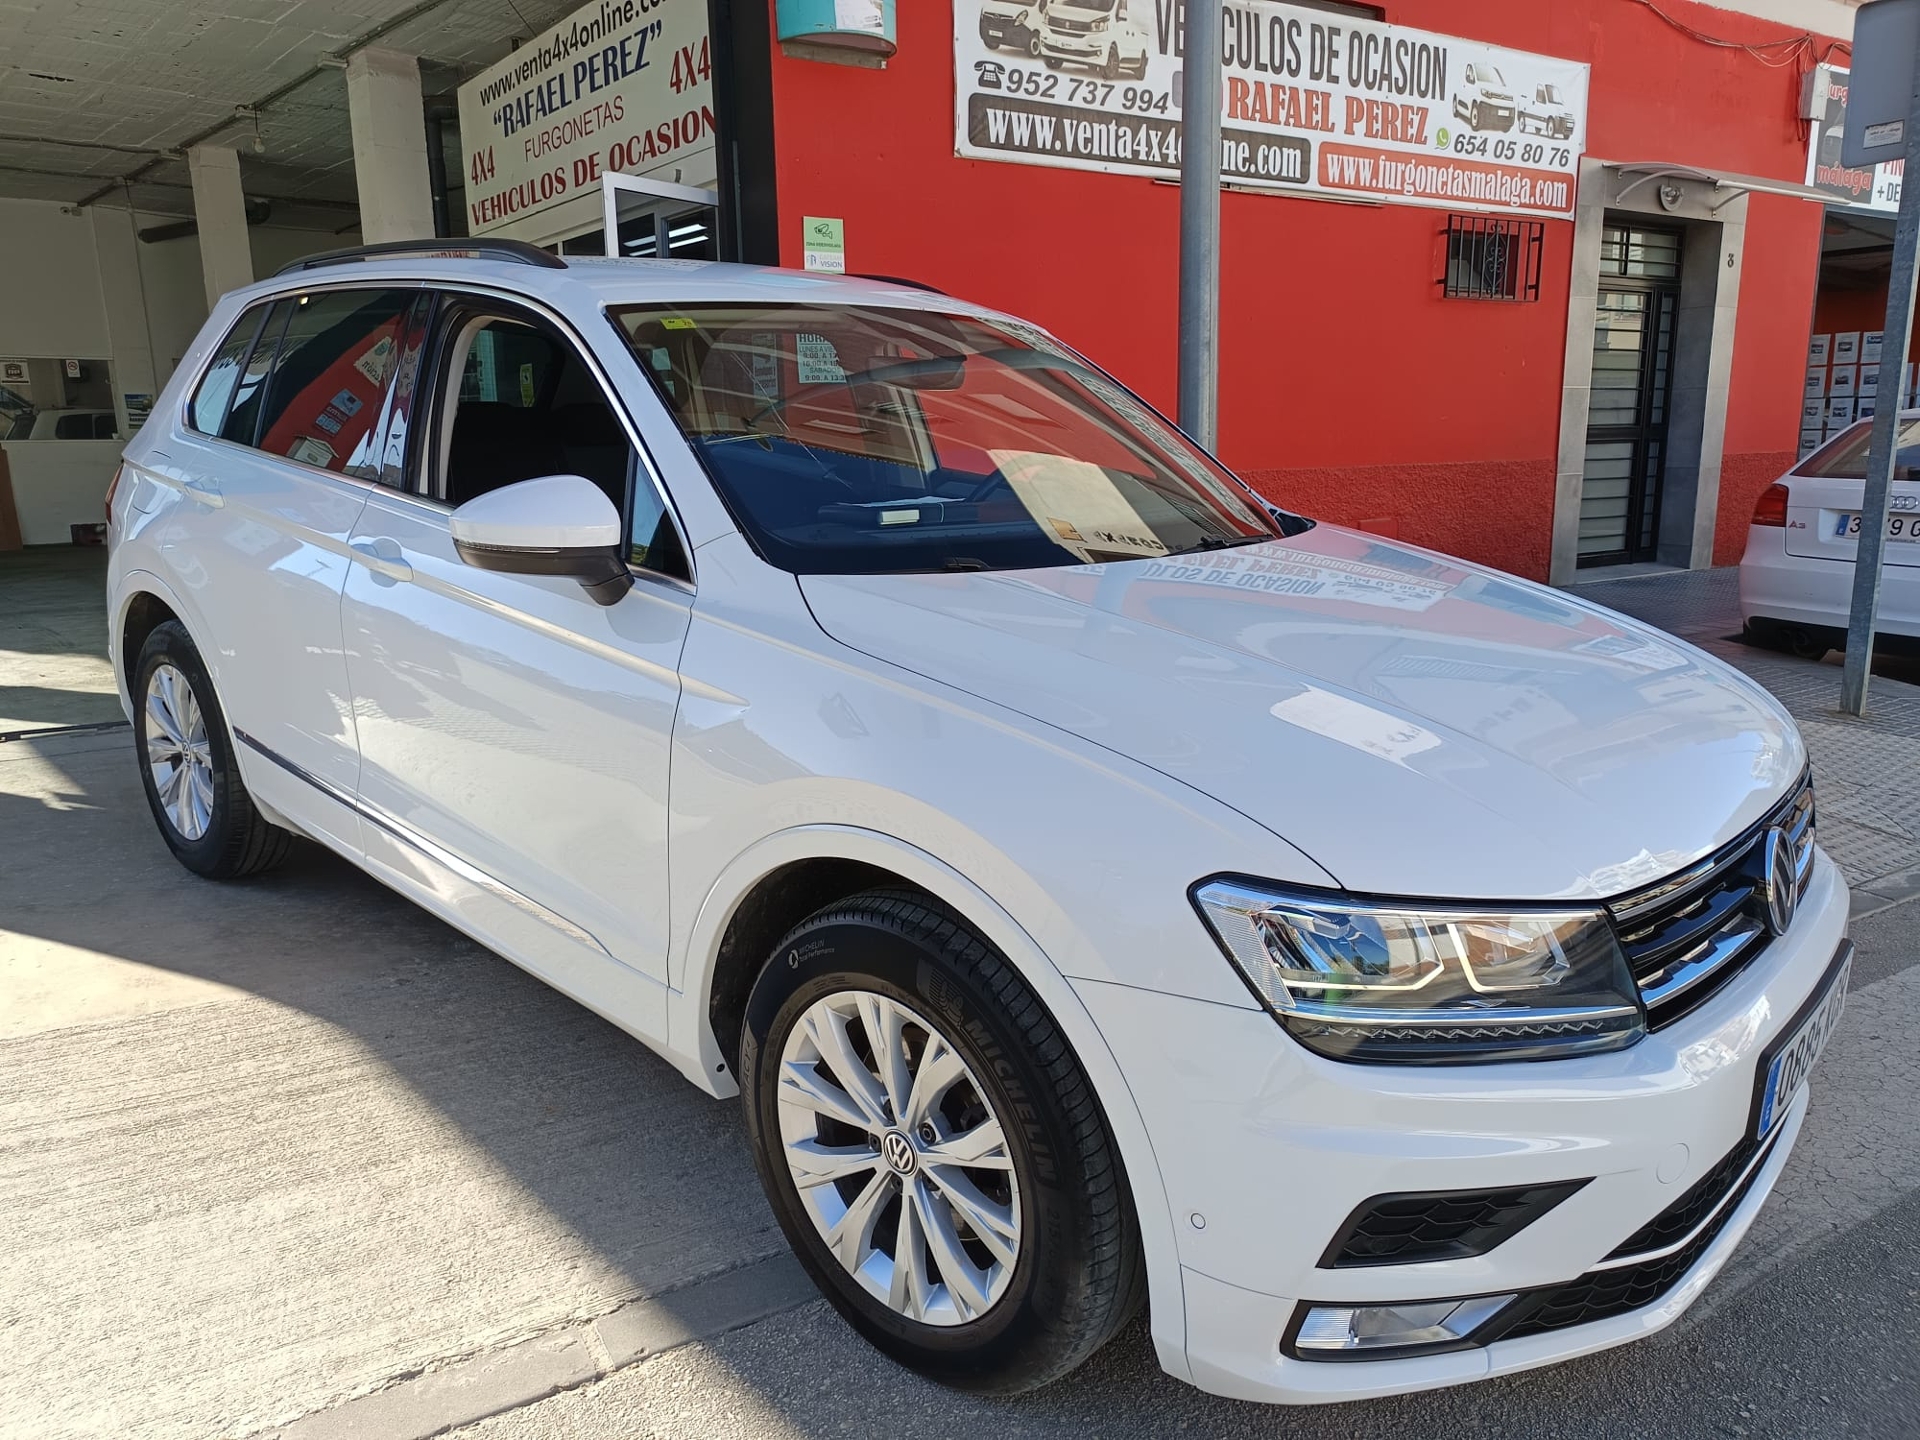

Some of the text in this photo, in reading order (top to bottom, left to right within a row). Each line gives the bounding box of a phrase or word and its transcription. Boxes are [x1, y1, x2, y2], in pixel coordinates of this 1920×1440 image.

[480, 0, 665, 107] www.venta4x4online.c
[670, 35, 712, 95] 4X4
[1155, 0, 1447, 101] VECULOS DE OCASION
[1006, 68, 1170, 114] 952 737 994
[1227, 76, 1429, 146] RAFAEL PEREZ
[524, 95, 624, 162] FURGONETAS
[986, 108, 1302, 179] www.venta4x4ne.com
[1453, 133, 1571, 167] 654 05 80 76
[471, 145, 496, 186] 4X4
[471, 105, 717, 226] VEHICULOS DE OCASION
[1326, 152, 1568, 208] www.furgonetasmalaga.com
[799, 333, 827, 343] HOR
[1789, 520, 1806, 529] A3
[1850, 516, 1904, 536] 39
[963, 1016, 1059, 1186] MICHELIN
